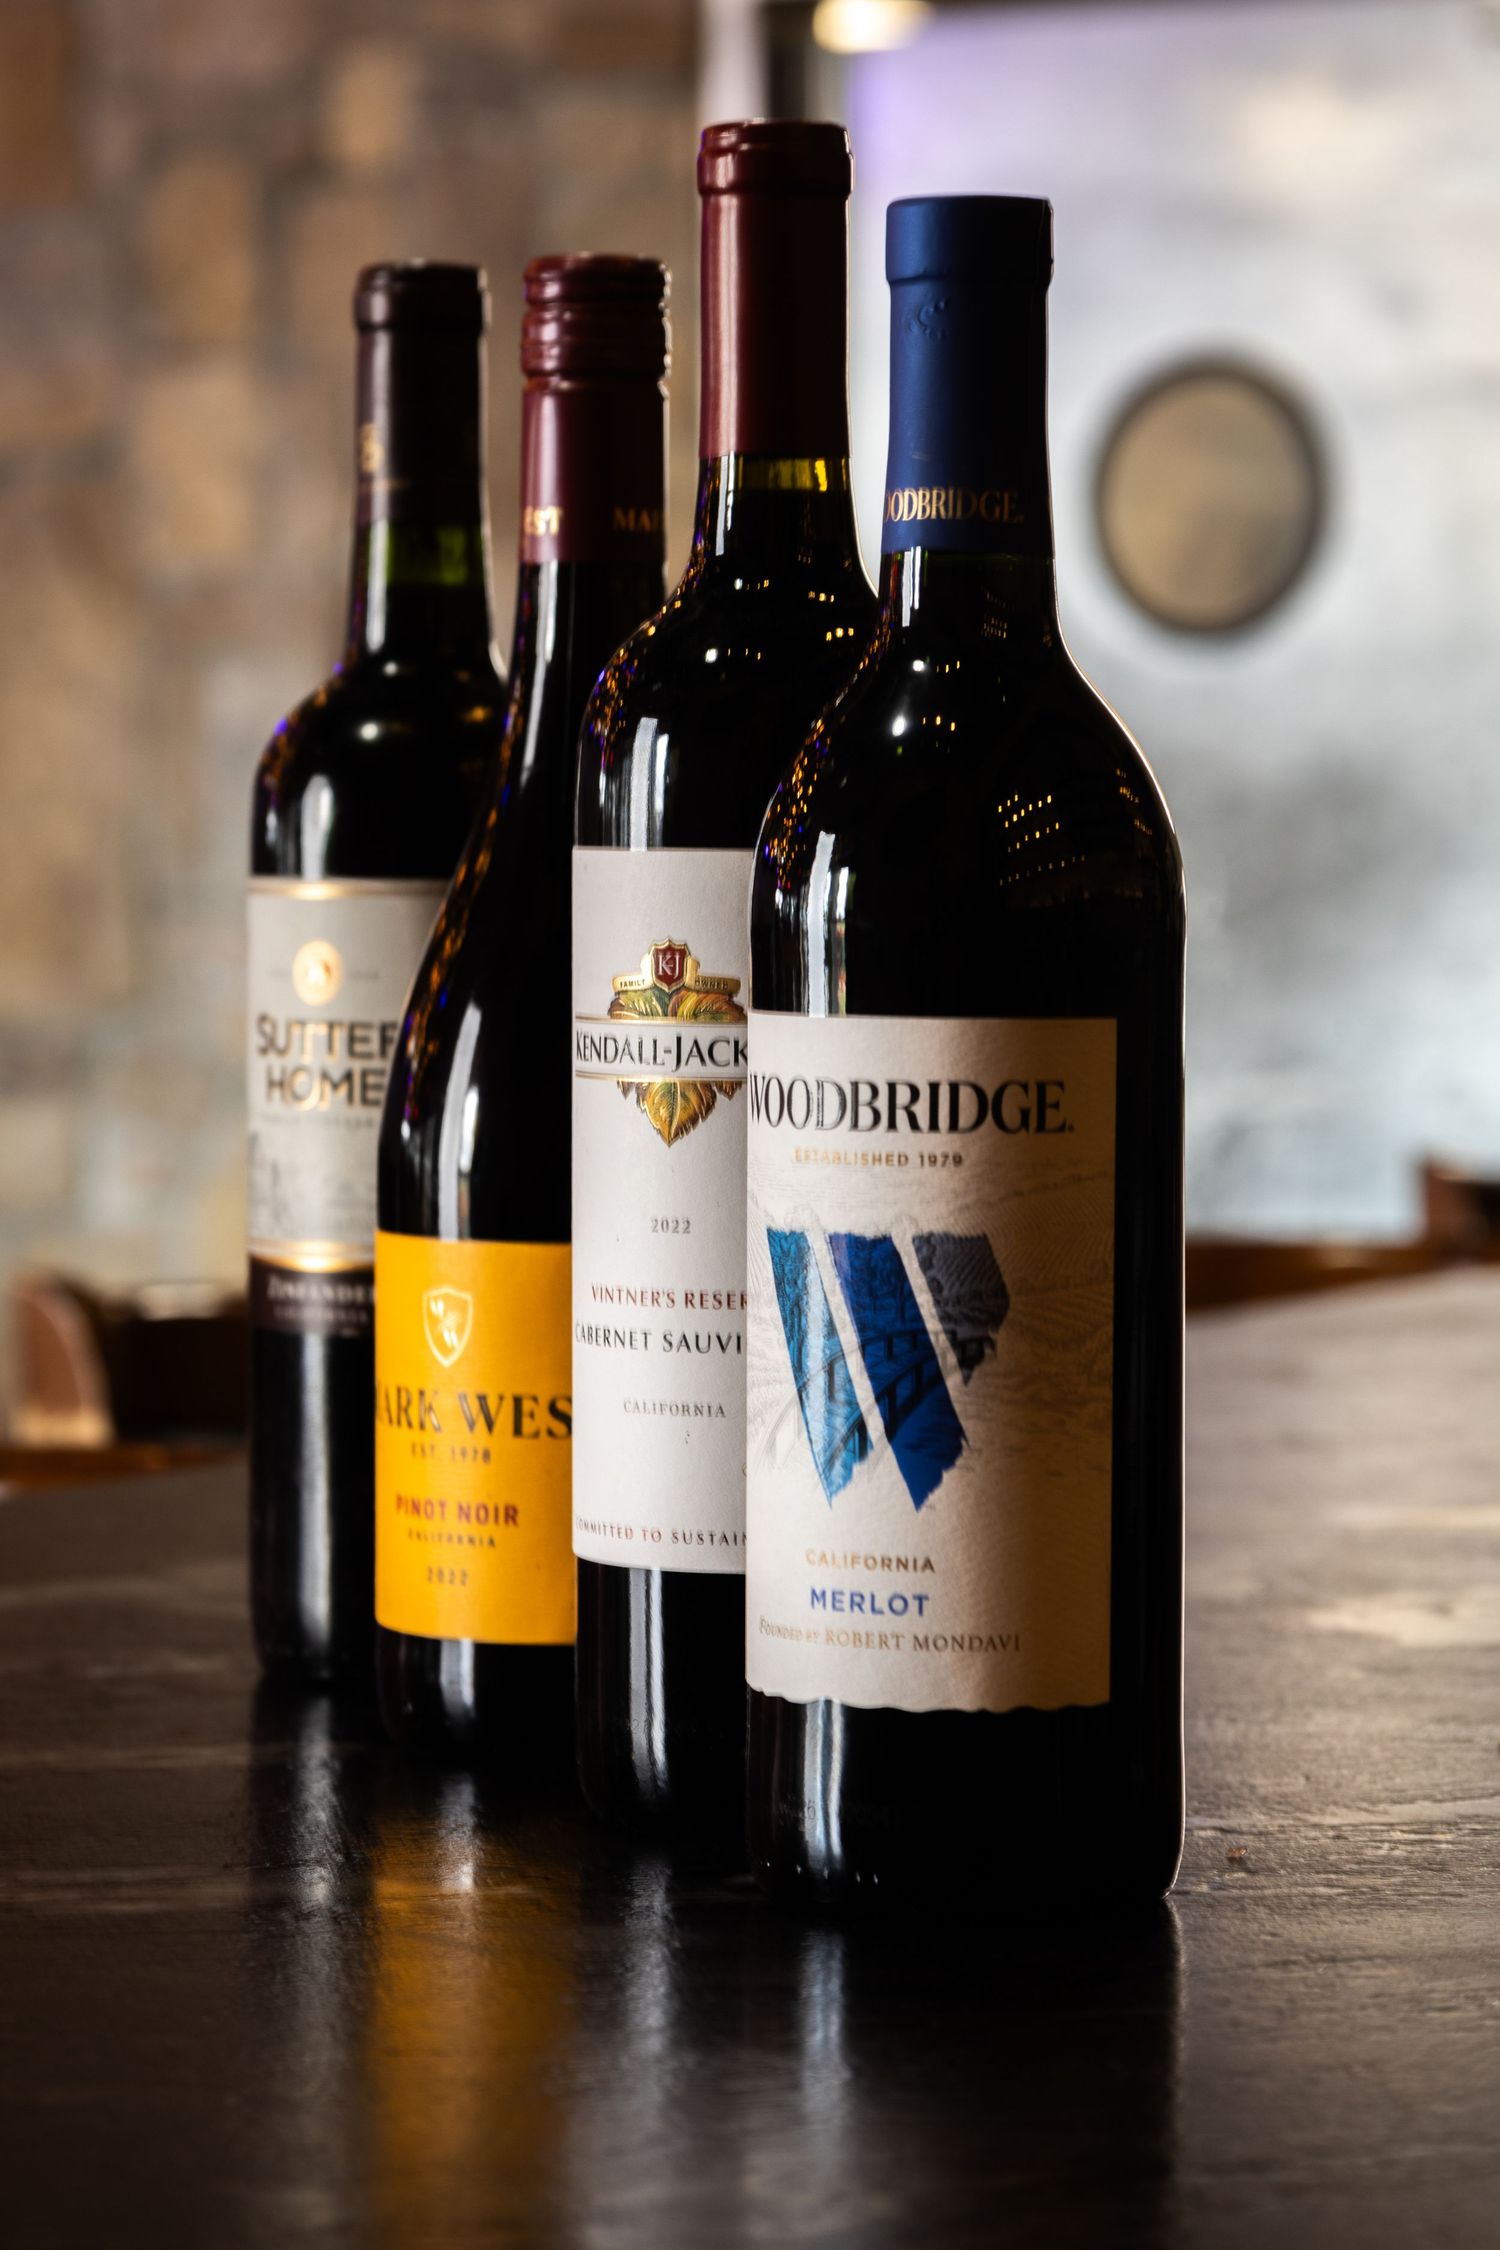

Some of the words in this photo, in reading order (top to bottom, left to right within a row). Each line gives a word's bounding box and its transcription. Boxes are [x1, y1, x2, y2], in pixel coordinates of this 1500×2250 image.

[266, 1065, 386, 1108] HOME
[795, 1147, 909, 1167] ESTABLISHED
[919, 1153, 963, 1168] 1979
[651, 1218, 691, 1235] 2022
[591, 1284, 676, 1310] VINTNER'S
[576, 1321, 652, 1351] CABERNET
[663, 1330, 742, 1354] SAUVI
[624, 1400, 727, 1419] CALIFORNIA
[396, 1493, 447, 1522] PINOT
[458, 1501, 519, 1527] NOIR
[641, 1528, 662, 1544] TO
[805, 1548, 936, 1575] CALIFORNIA
[810, 1586, 930, 1618] MERLOT
[826, 1627, 905, 1650] ROBERT
[913, 1632, 1022, 1653] MONDAVI
